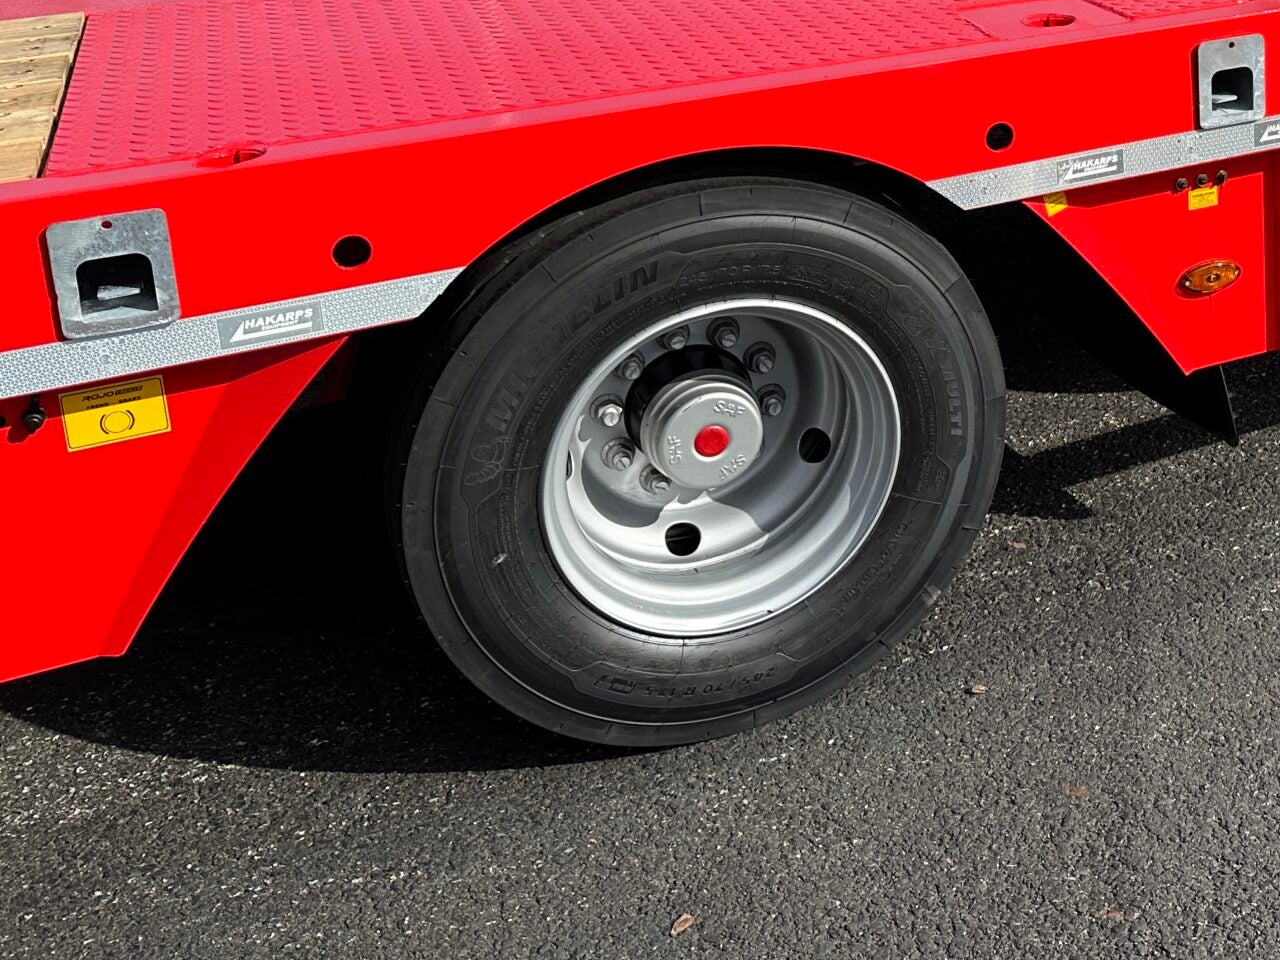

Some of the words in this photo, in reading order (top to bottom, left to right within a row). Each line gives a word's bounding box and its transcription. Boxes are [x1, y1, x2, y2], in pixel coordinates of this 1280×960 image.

[1073, 154, 1119, 170] HAKARPS
[244, 308, 313, 330] HAKARPS
[713, 399, 747, 418] SAF
[666, 434, 683, 466] SAF
